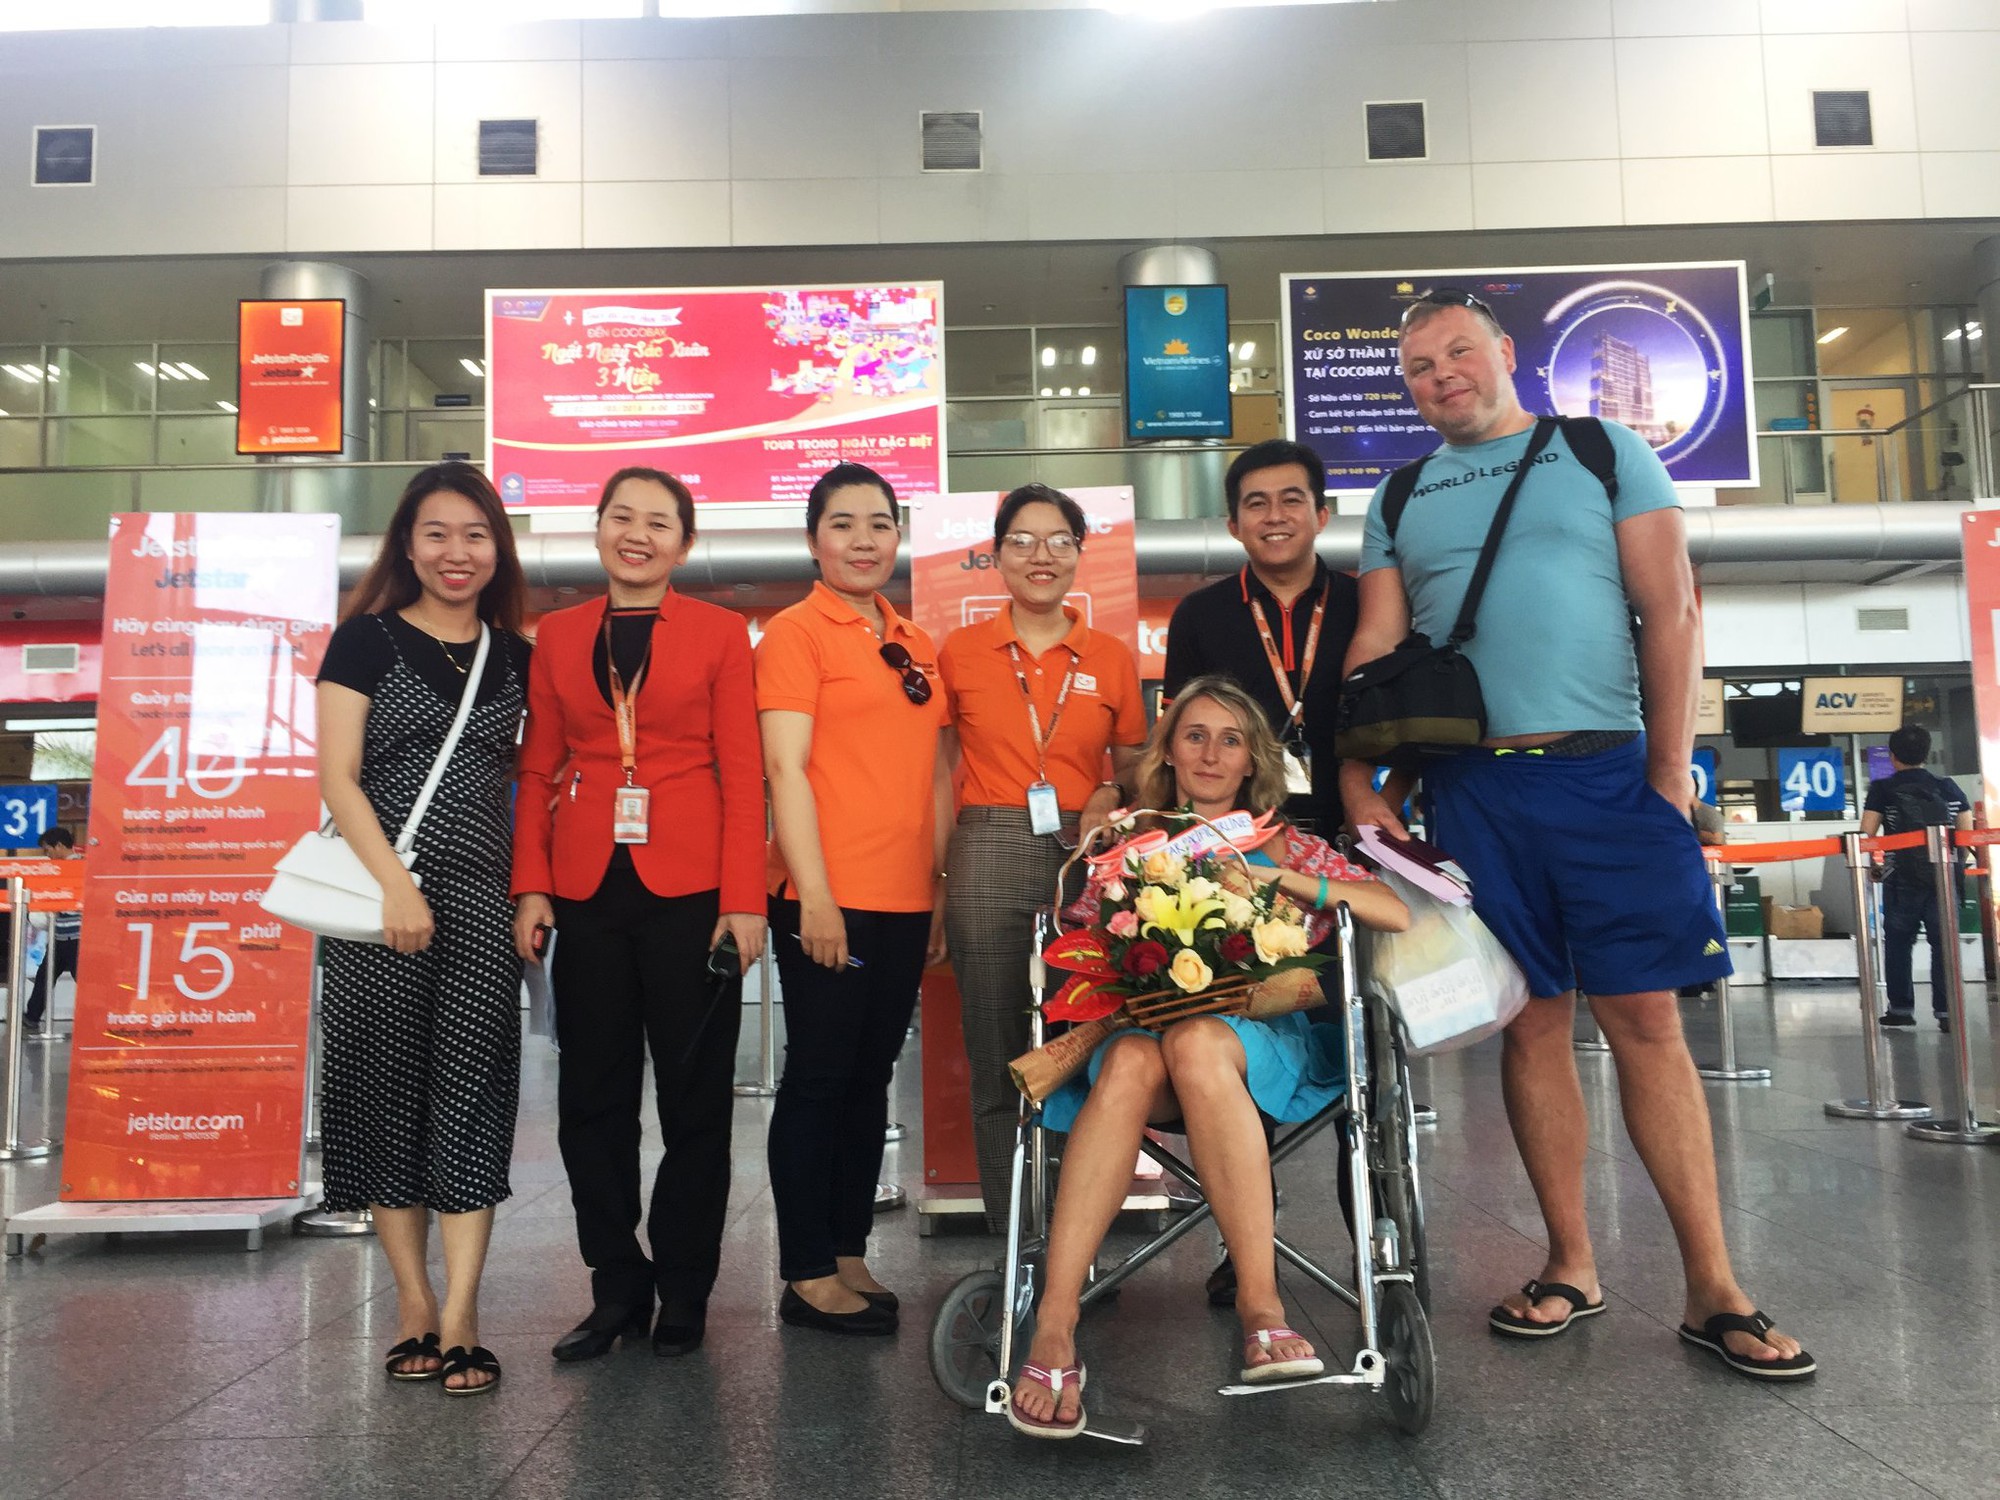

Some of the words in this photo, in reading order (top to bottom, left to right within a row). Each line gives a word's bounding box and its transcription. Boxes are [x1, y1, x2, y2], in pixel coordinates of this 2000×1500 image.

[1303, 329, 1342, 341] Coco
[1345, 327, 1399, 340] Wonde
[1326, 346, 1346, 360] SỞ
[1347, 345, 1386, 359] THẦN
[595, 367, 610, 387] 3
[1304, 367, 1327, 380] TẠI
[1329, 366, 1391, 378] COCOBAY
[1308, 410, 1328, 418] Cam
[763, 439, 795, 450] TOUR
[797, 438, 839, 450] TRONG
[841, 435, 877, 449] NGÀY
[1412, 471, 1476, 499] WORLD
[1479, 452, 1560, 478] LEGND
[155, 567, 250, 590] Jetstar
[113, 617, 149, 636] Hãy
[152, 616, 196, 637] cùng
[131, 642, 166, 657] Let's
[169, 642, 190, 657] all
[1815, 692, 1857, 708] ACV
[1785, 760, 1836, 799] 40
[4, 798, 48, 837] 31
[226, 805, 266, 820] hành
[151, 892, 168, 903] ra
[209, 889, 240, 905] bay
[127, 921, 235, 1001] 15
[239, 921, 283, 942] phút
[216, 1009, 257, 1024] hành
[126, 1112, 244, 1135] jetstar.com
